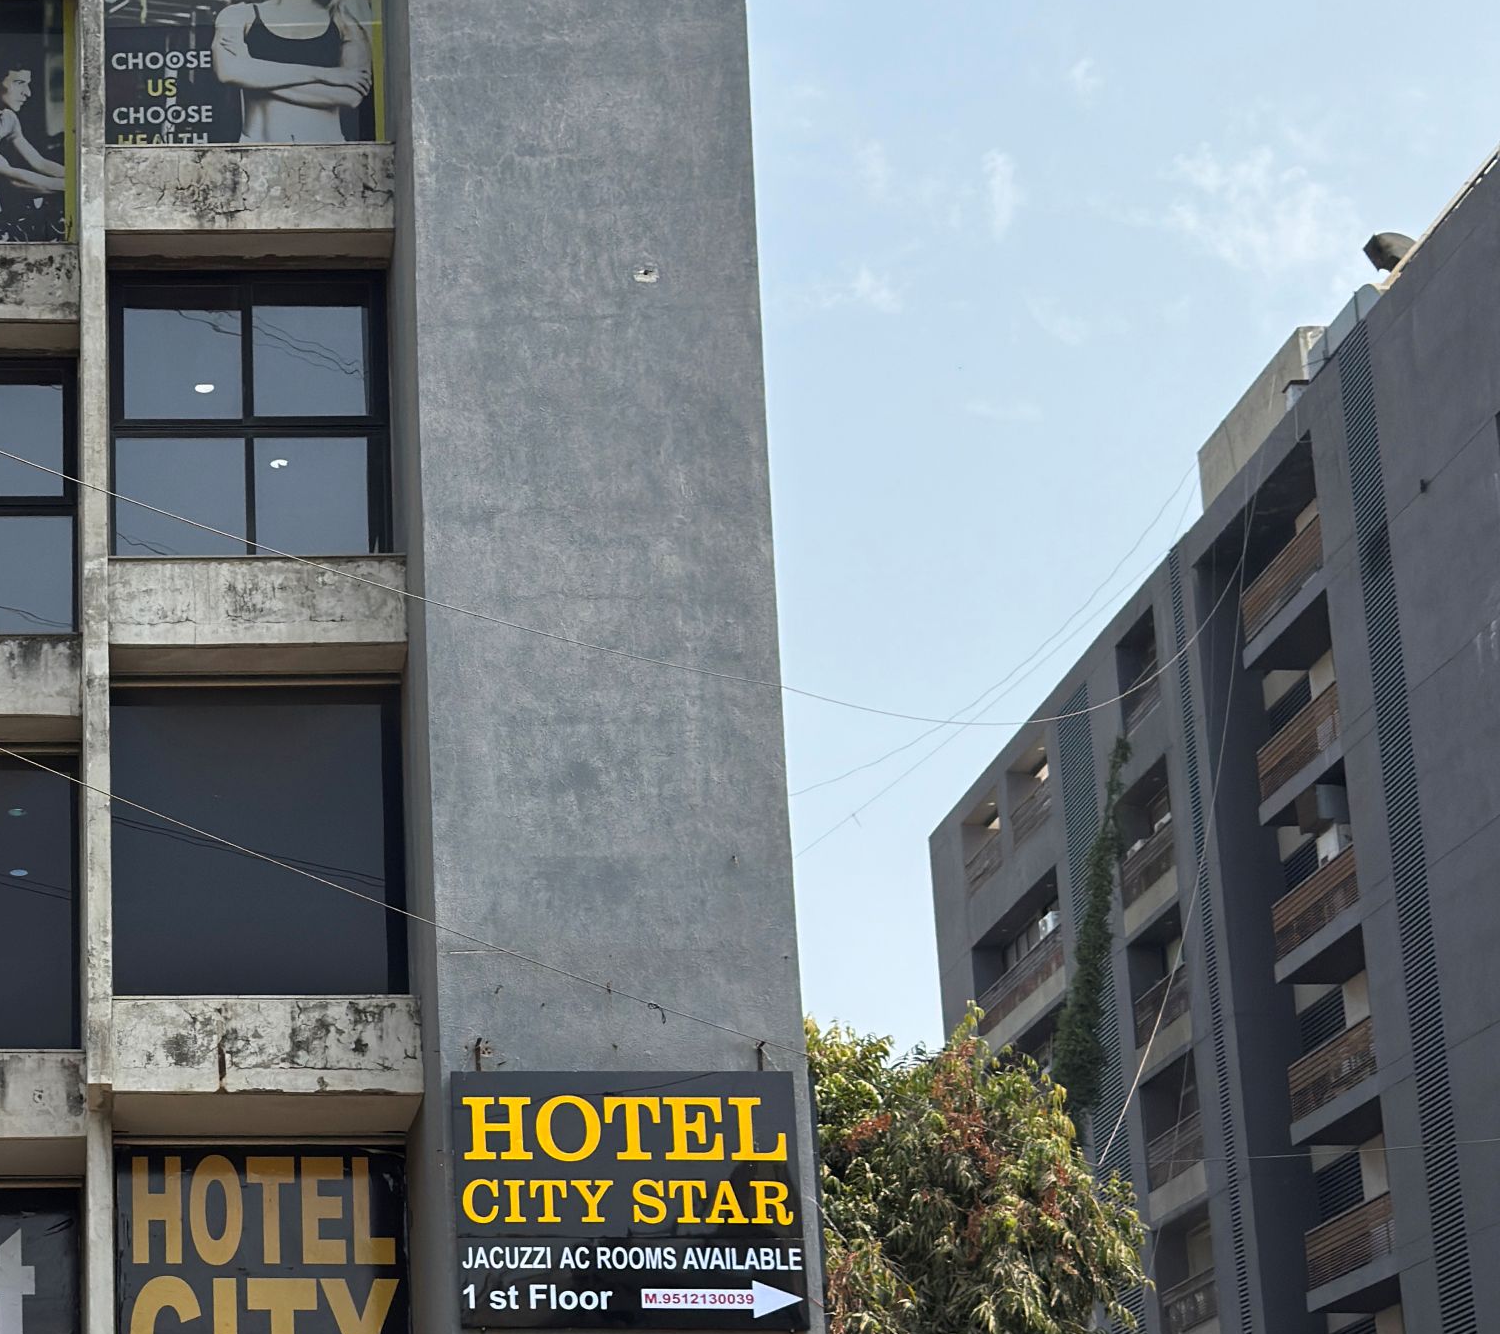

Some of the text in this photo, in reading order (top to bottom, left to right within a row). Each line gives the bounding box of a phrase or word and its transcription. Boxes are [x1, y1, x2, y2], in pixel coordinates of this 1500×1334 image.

[111, 51, 211, 70] CHOOSE
[147, 79, 177, 97] US
[112, 106, 213, 125] CHOOSE
[462, 1095, 788, 1162] HOTEL
[131, 1154, 396, 1266] HOTEL
[462, 1178, 795, 1225] CITY STAR
[462, 1246, 803, 1271] JACUZZI AC ROOMS AVAILABLE
[529, 1284, 613, 1310] Floor
[644, 1293, 754, 1305] M.9512130039
